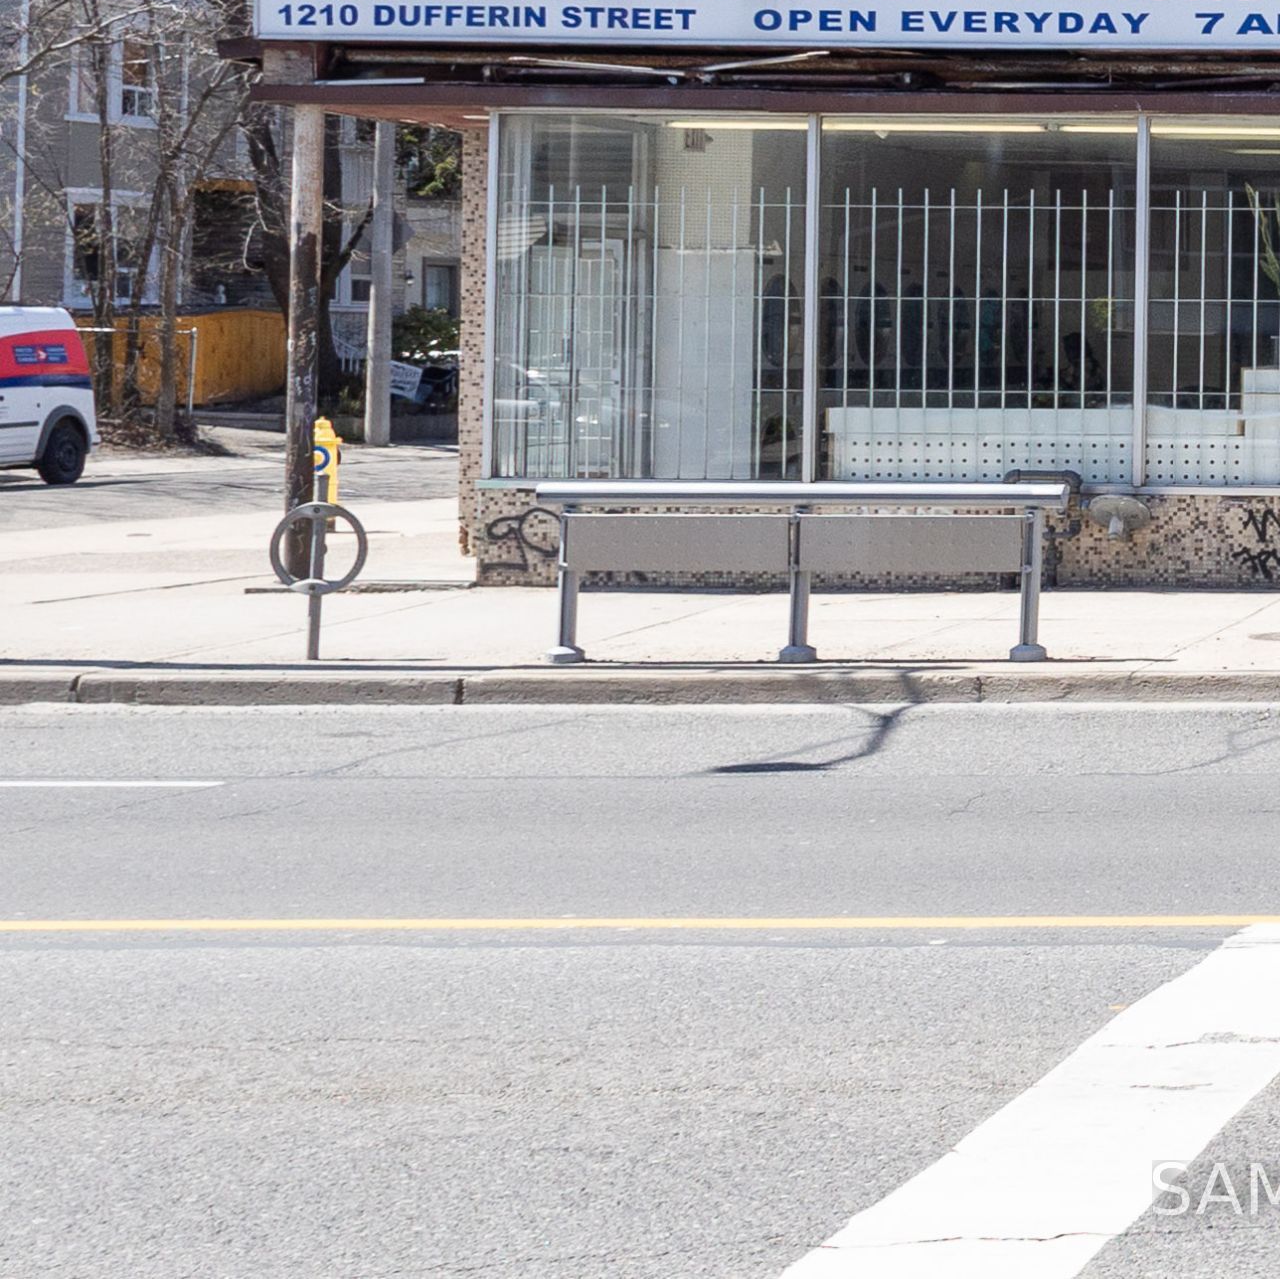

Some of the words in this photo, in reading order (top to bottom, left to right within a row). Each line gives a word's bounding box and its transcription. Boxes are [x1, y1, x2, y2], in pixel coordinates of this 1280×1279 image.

[277, 3, 359, 27] 1210
[373, 4, 547, 28] DUFFERIN
[560, 6, 697, 31] STREET
[752, 8, 878, 33] OPEN
[900, 9, 1150, 34] EVERYDAY
